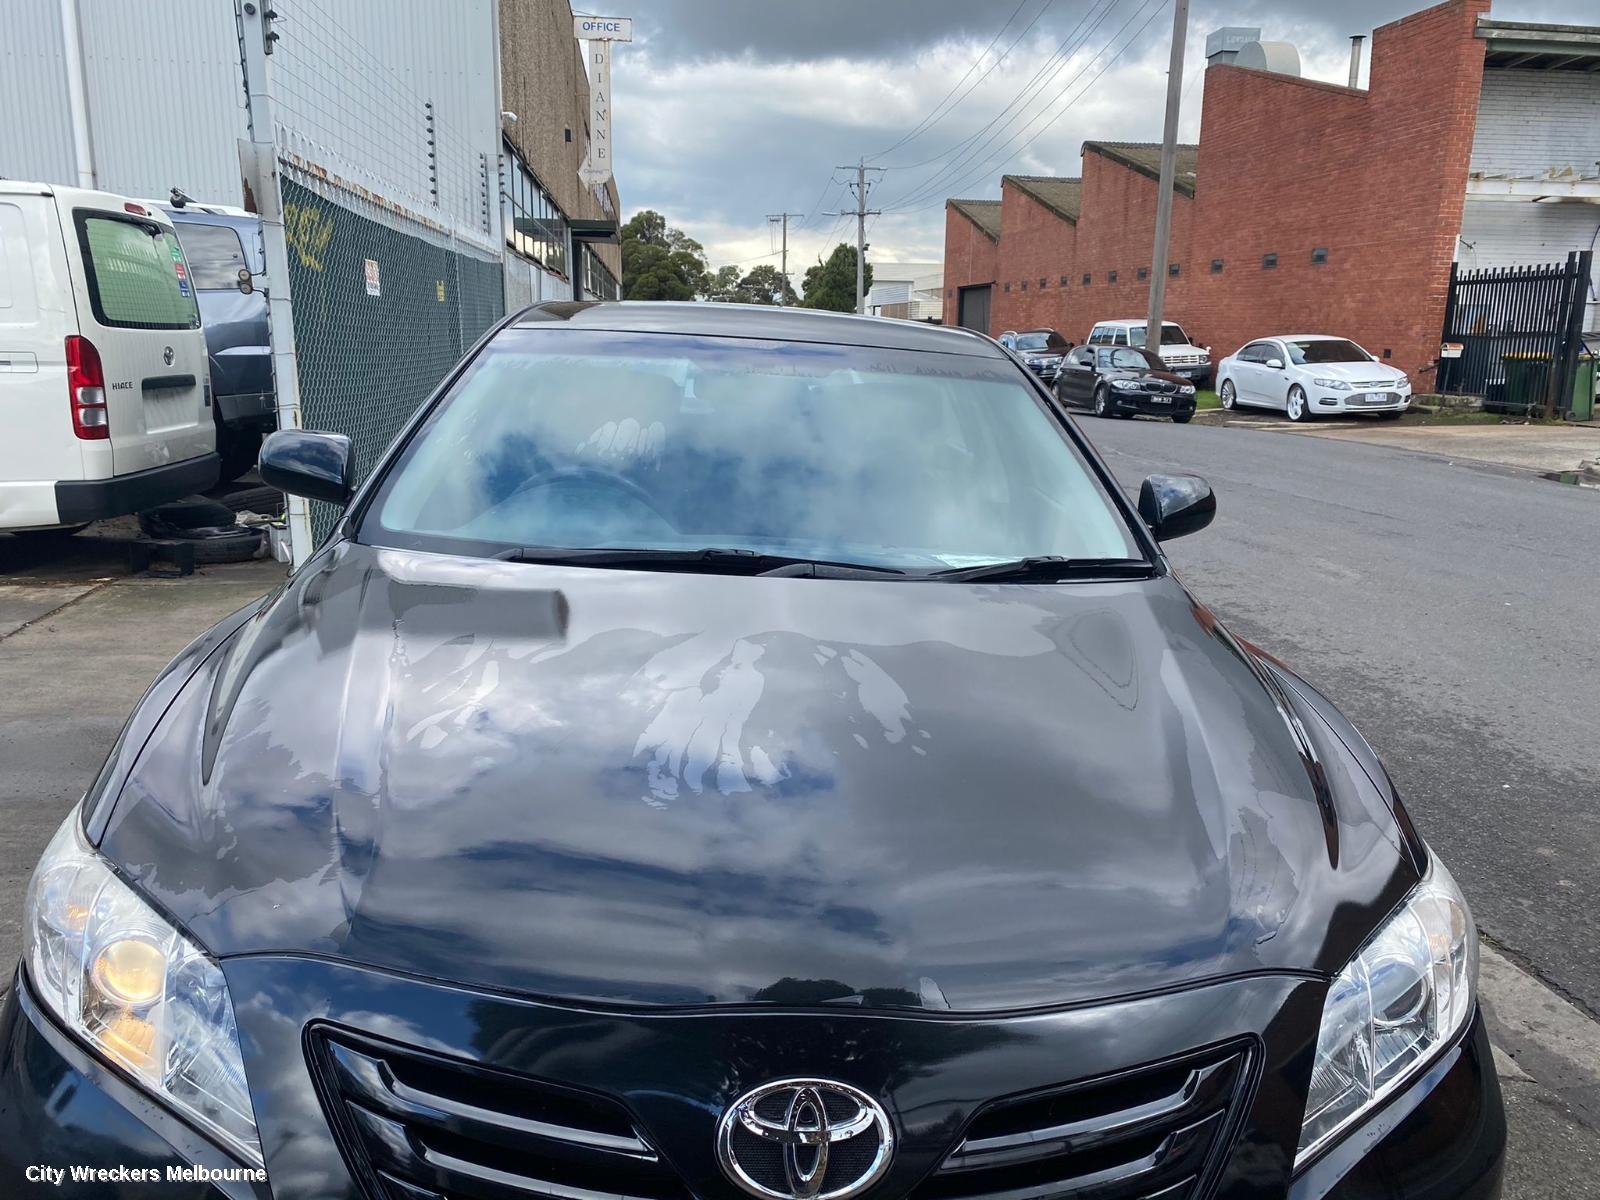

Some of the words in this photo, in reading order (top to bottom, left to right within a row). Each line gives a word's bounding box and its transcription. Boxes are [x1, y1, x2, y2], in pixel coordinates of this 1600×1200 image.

[582, 21, 621, 32] OFFICE
[595, 53, 607, 159] DIANNE
[112, 381, 133, 390] HIACE
